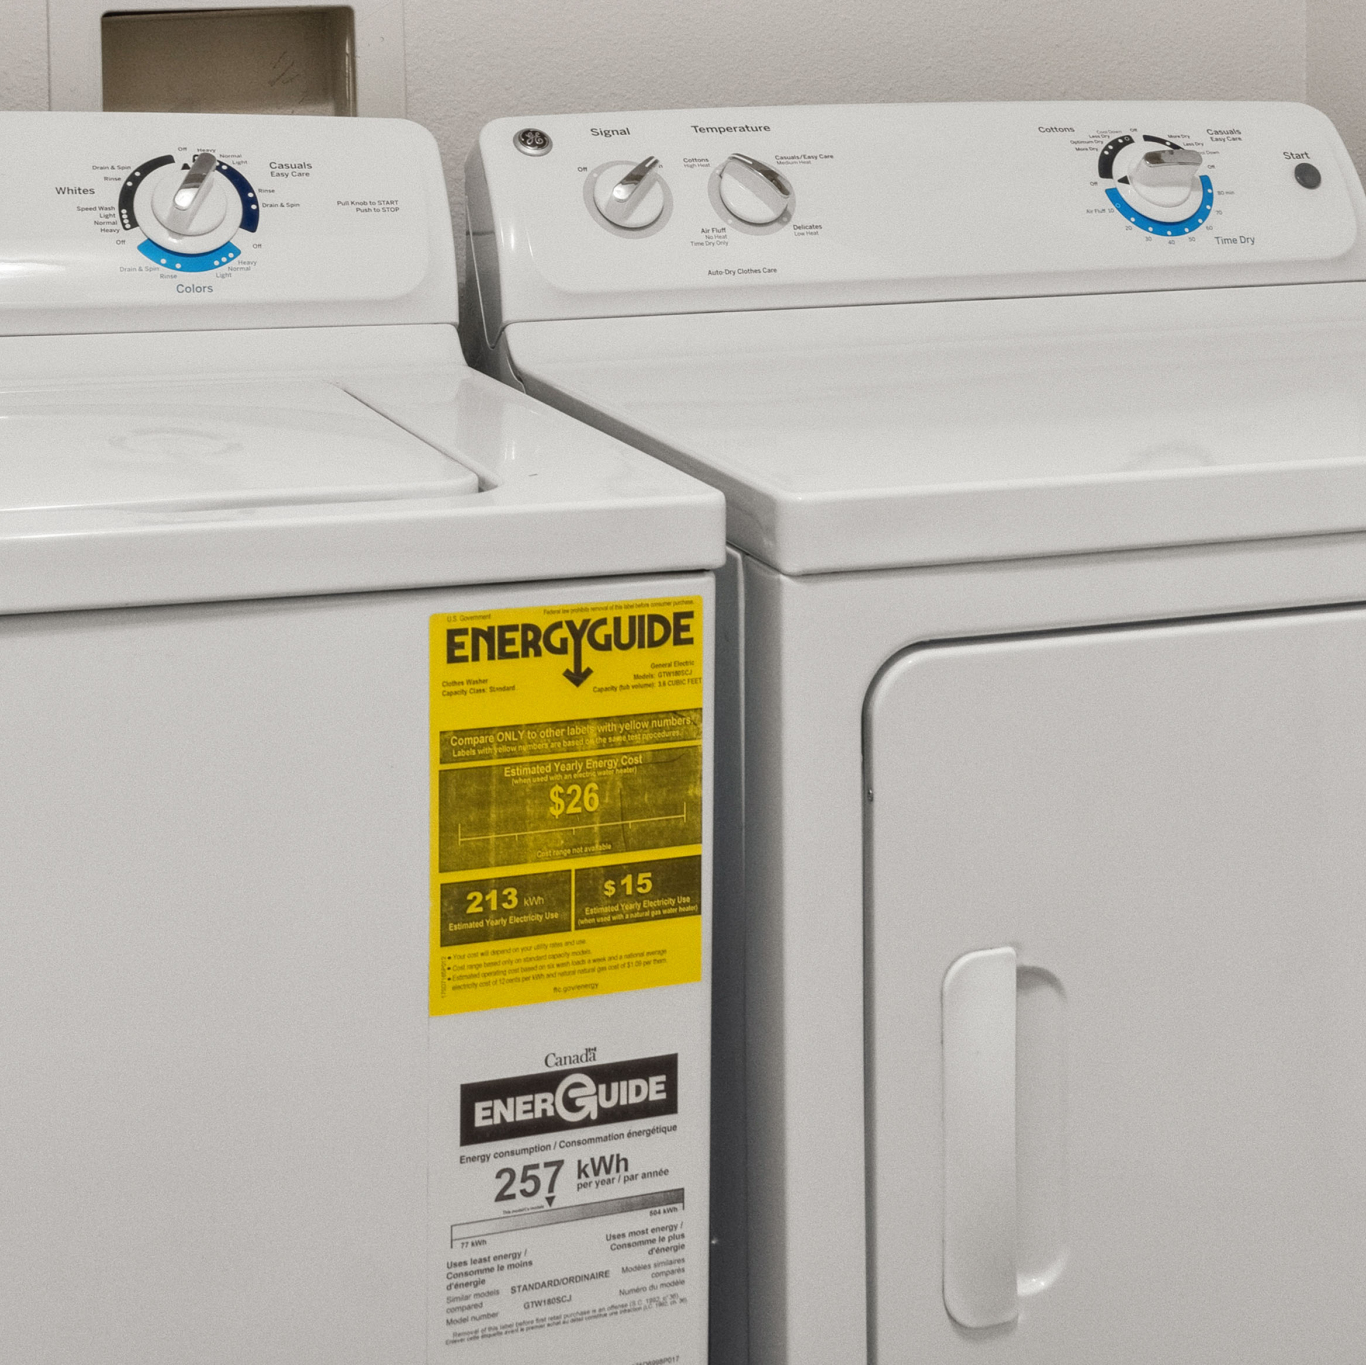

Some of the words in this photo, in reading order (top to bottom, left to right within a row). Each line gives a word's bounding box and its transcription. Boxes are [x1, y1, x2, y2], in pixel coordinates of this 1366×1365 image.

[590, 127, 631, 137] Signal
[691, 125, 771, 134] Temperature
[1283, 152, 1310, 160] Start
[55, 187, 96, 195] Whites
[1214, 236, 1237, 245] Time
[1239, 235, 1255, 245] Dry
[176, 284, 214, 294] Colors
[446, 611, 694, 664] ENERGYGUIDE
[450, 734, 494, 747] Compare
[497, 730, 525, 742] ONLY
[527, 731, 537, 739] to
[540, 728, 565, 738] other
[567, 724, 594, 736] labels
[596, 722, 617, 733] with
[619, 720, 649, 733] yellow
[651, 716, 693, 728] numbers.
[504, 764, 551, 777] Estimated
[553, 759, 583, 773] Yearly
[586, 757, 619, 770] Energy
[621, 755, 643, 766] Cost
[549, 782, 599, 819] $26
[584, 843, 612, 852] available
[604, 879, 616, 897] $
[620, 872, 653, 895] 15
[466, 887, 518, 914] 213
[524, 896, 544, 906] kWh
[585, 904, 619, 915] Estimated
[620, 901, 641, 911] Yearly
[643, 897, 675, 908] Electricity
[448, 920, 484, 931] Estimated
[485, 917, 507, 927] Yearly
[509, 913, 543, 924] Electricity
[544, 912, 559, 920] Use
[544, 1047, 597, 1068] Canada
[474, 1073, 667, 1128] ENERGUIDE
[459, 1152, 491, 1165] Energy
[494, 1143, 551, 1159] consumption
[553, 1141, 558, 1151] /
[559, 1132, 625, 1149] Consommation
[627, 1124, 678, 1140] énergétique
[494, 1159, 565, 1202] 257
[577, 1153, 629, 1180] kWh
[577, 1180, 591, 1192] per
[594, 1177, 616, 1189] year
[618, 1174, 622, 1183] /
[624, 1173, 639, 1183] par
[641, 1168, 669, 1179] année
[606, 1232, 626, 1241] Uses
[628, 1228, 648, 1237] most
[650, 1224, 678, 1233] energy
[610, 1238, 656, 1251] Consomme
[668, 1232, 685, 1242] plus
[648, 1243, 685, 1255] d'énergie
[446, 1260, 468, 1269] Uses
[470, 1256, 490, 1265] least
[493, 1251, 522, 1262] energy
[621, 1263, 651, 1274] Modèles
[654, 1258, 685, 1268] similaires
[446, 1266, 495, 1280] Consomme
[507, 1260, 533, 1270] moins
[651, 1267, 685, 1279] comparés
[446, 1278, 486, 1291] d'énergie
[510, 1270, 611, 1294] STANDARD/ORDINAIRE
[619, 1285, 647, 1296] Numéro
[660, 1279, 685, 1289] modèle
[446, 1294, 471, 1304] Similar
[473, 1289, 500, 1299] models
[524, 1295, 572, 1310] GTW180SCJ
[446, 1302, 483, 1314] compared
[446, 1316, 469, 1326] Model
[471, 1311, 499, 1322] number
